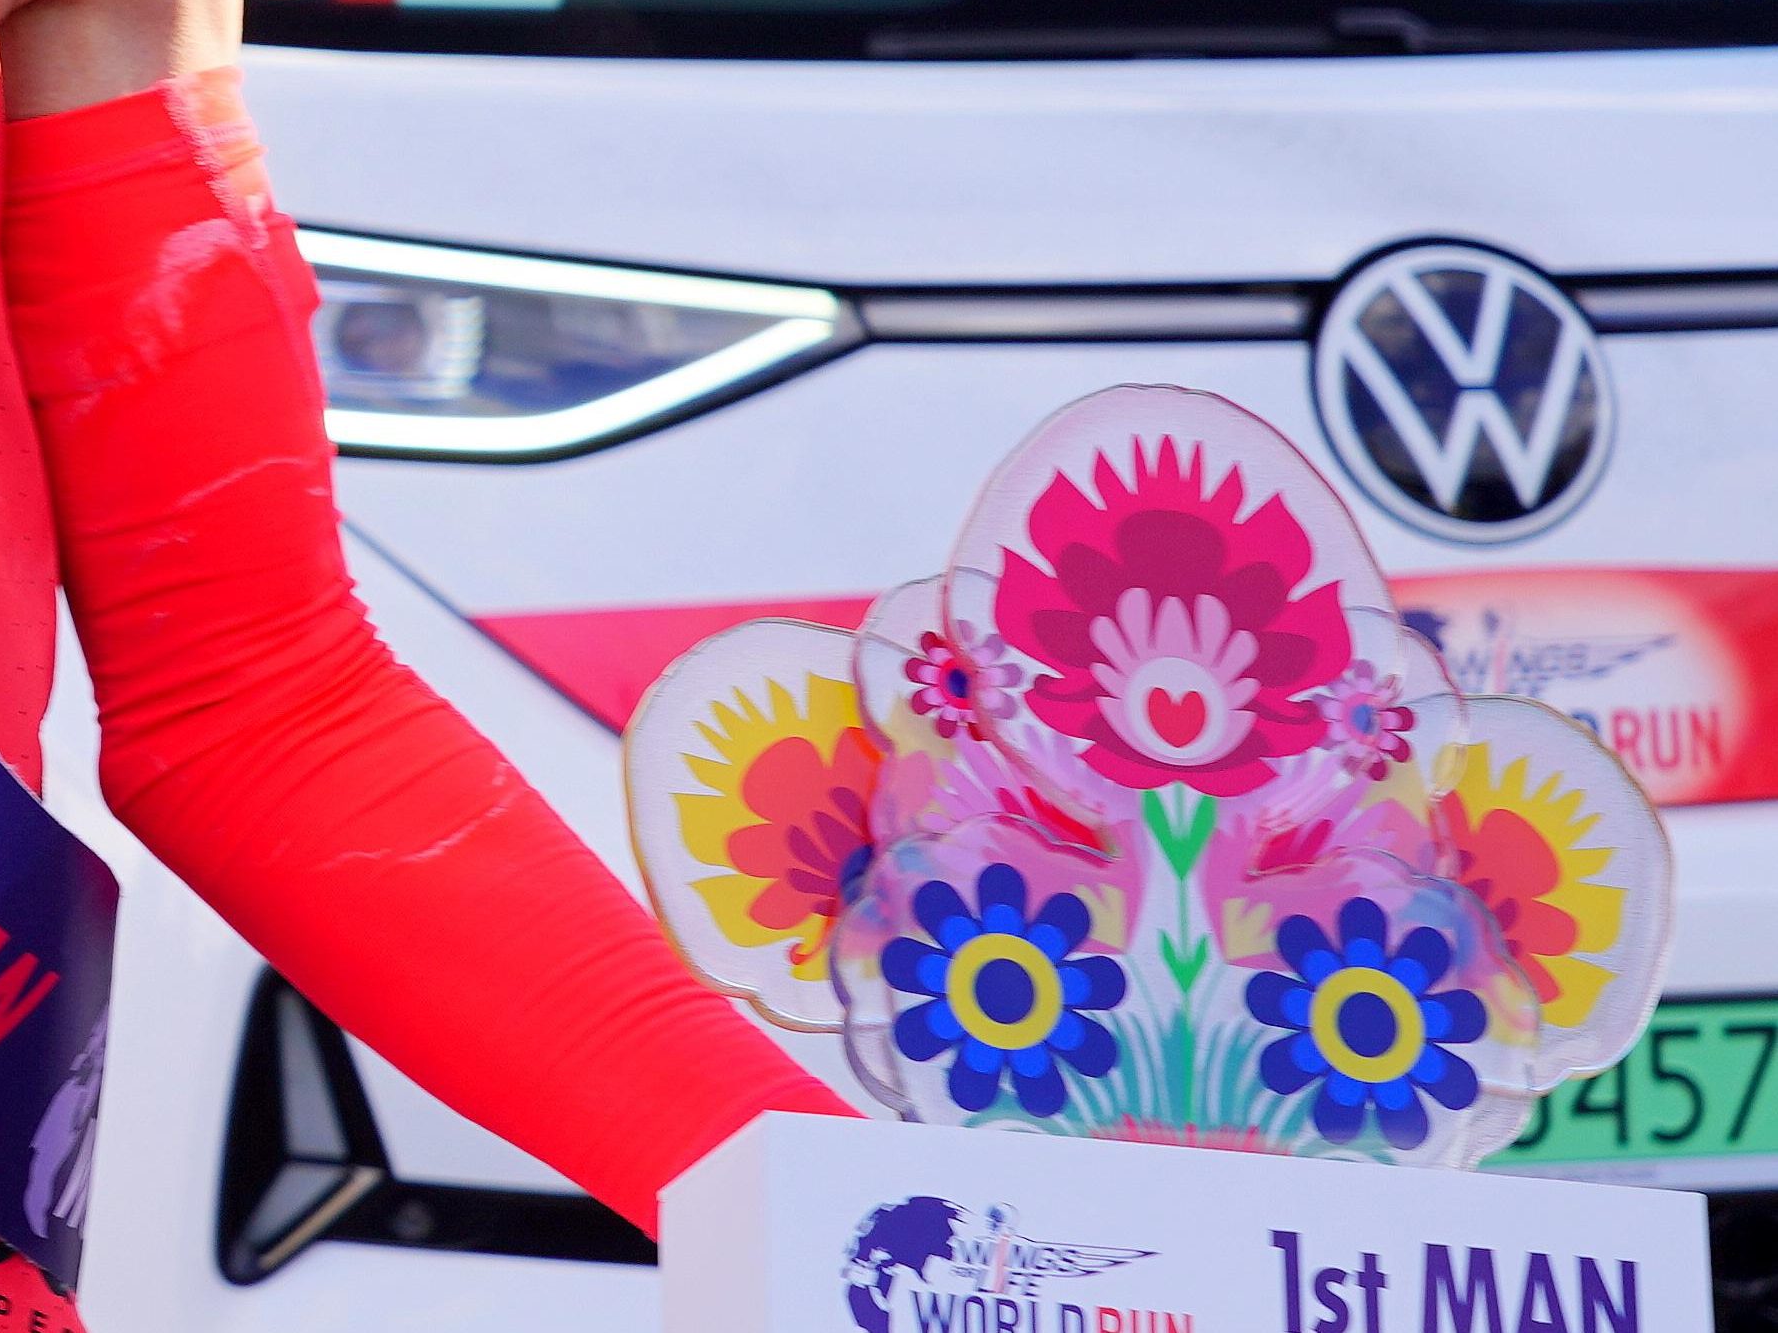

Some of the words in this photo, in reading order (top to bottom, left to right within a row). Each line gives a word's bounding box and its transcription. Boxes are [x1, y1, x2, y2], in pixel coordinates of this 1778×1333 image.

[1609, 706, 1722, 771] RUN
[909, 1290, 1085, 1333] WORLD
[1268, 1229, 1388, 1333] 1st
[1421, 1242, 1640, 1333] MAN
